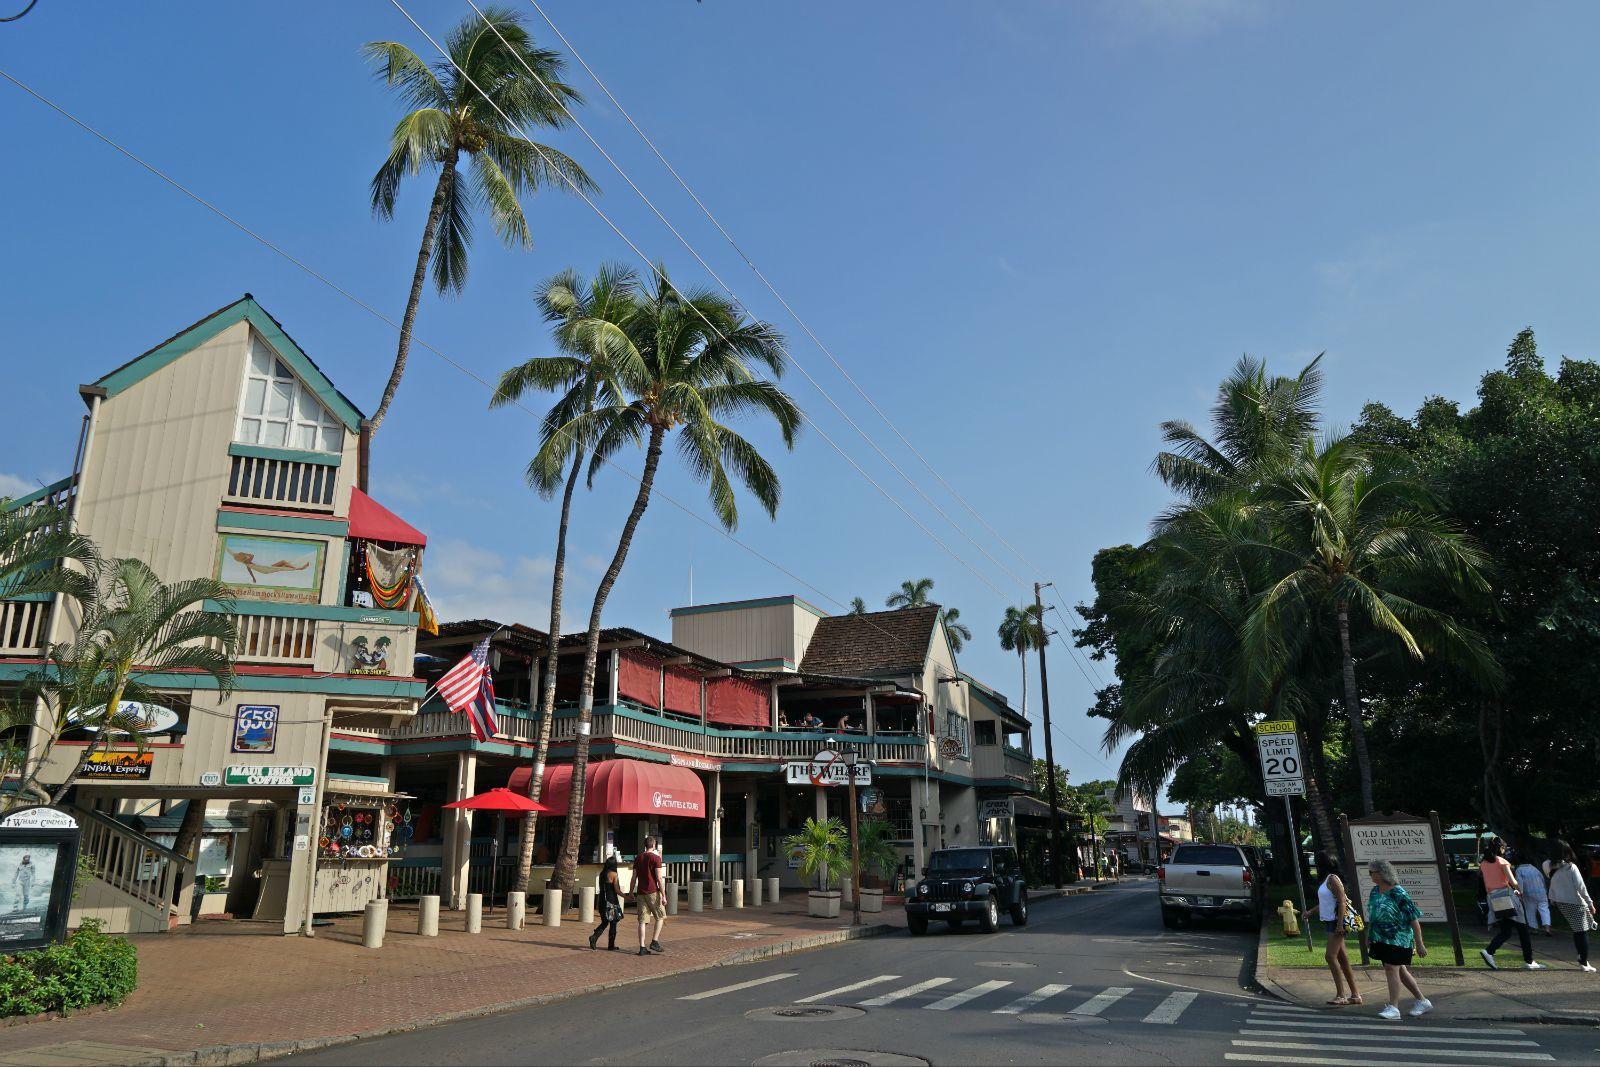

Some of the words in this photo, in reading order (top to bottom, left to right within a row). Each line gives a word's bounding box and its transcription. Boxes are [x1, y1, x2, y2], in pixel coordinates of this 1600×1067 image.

[240, 710, 274, 736] 658
[1260, 723, 1292, 732] SCHOOL
[1262, 739, 1294, 747] SPEED
[1267, 748, 1291, 756] LIMIT
[1266, 757, 1297, 775] 20
[230, 766, 263, 776] MAUI
[268, 767, 312, 777] ISLAND
[789, 764, 817, 779] THE
[247, 775, 294, 785] COFFEE
[1357, 830, 1378, 838] OLD
[1380, 829, 1425, 838] LAHAINA
[1360, 838, 1426, 846] COURTHOUSE
